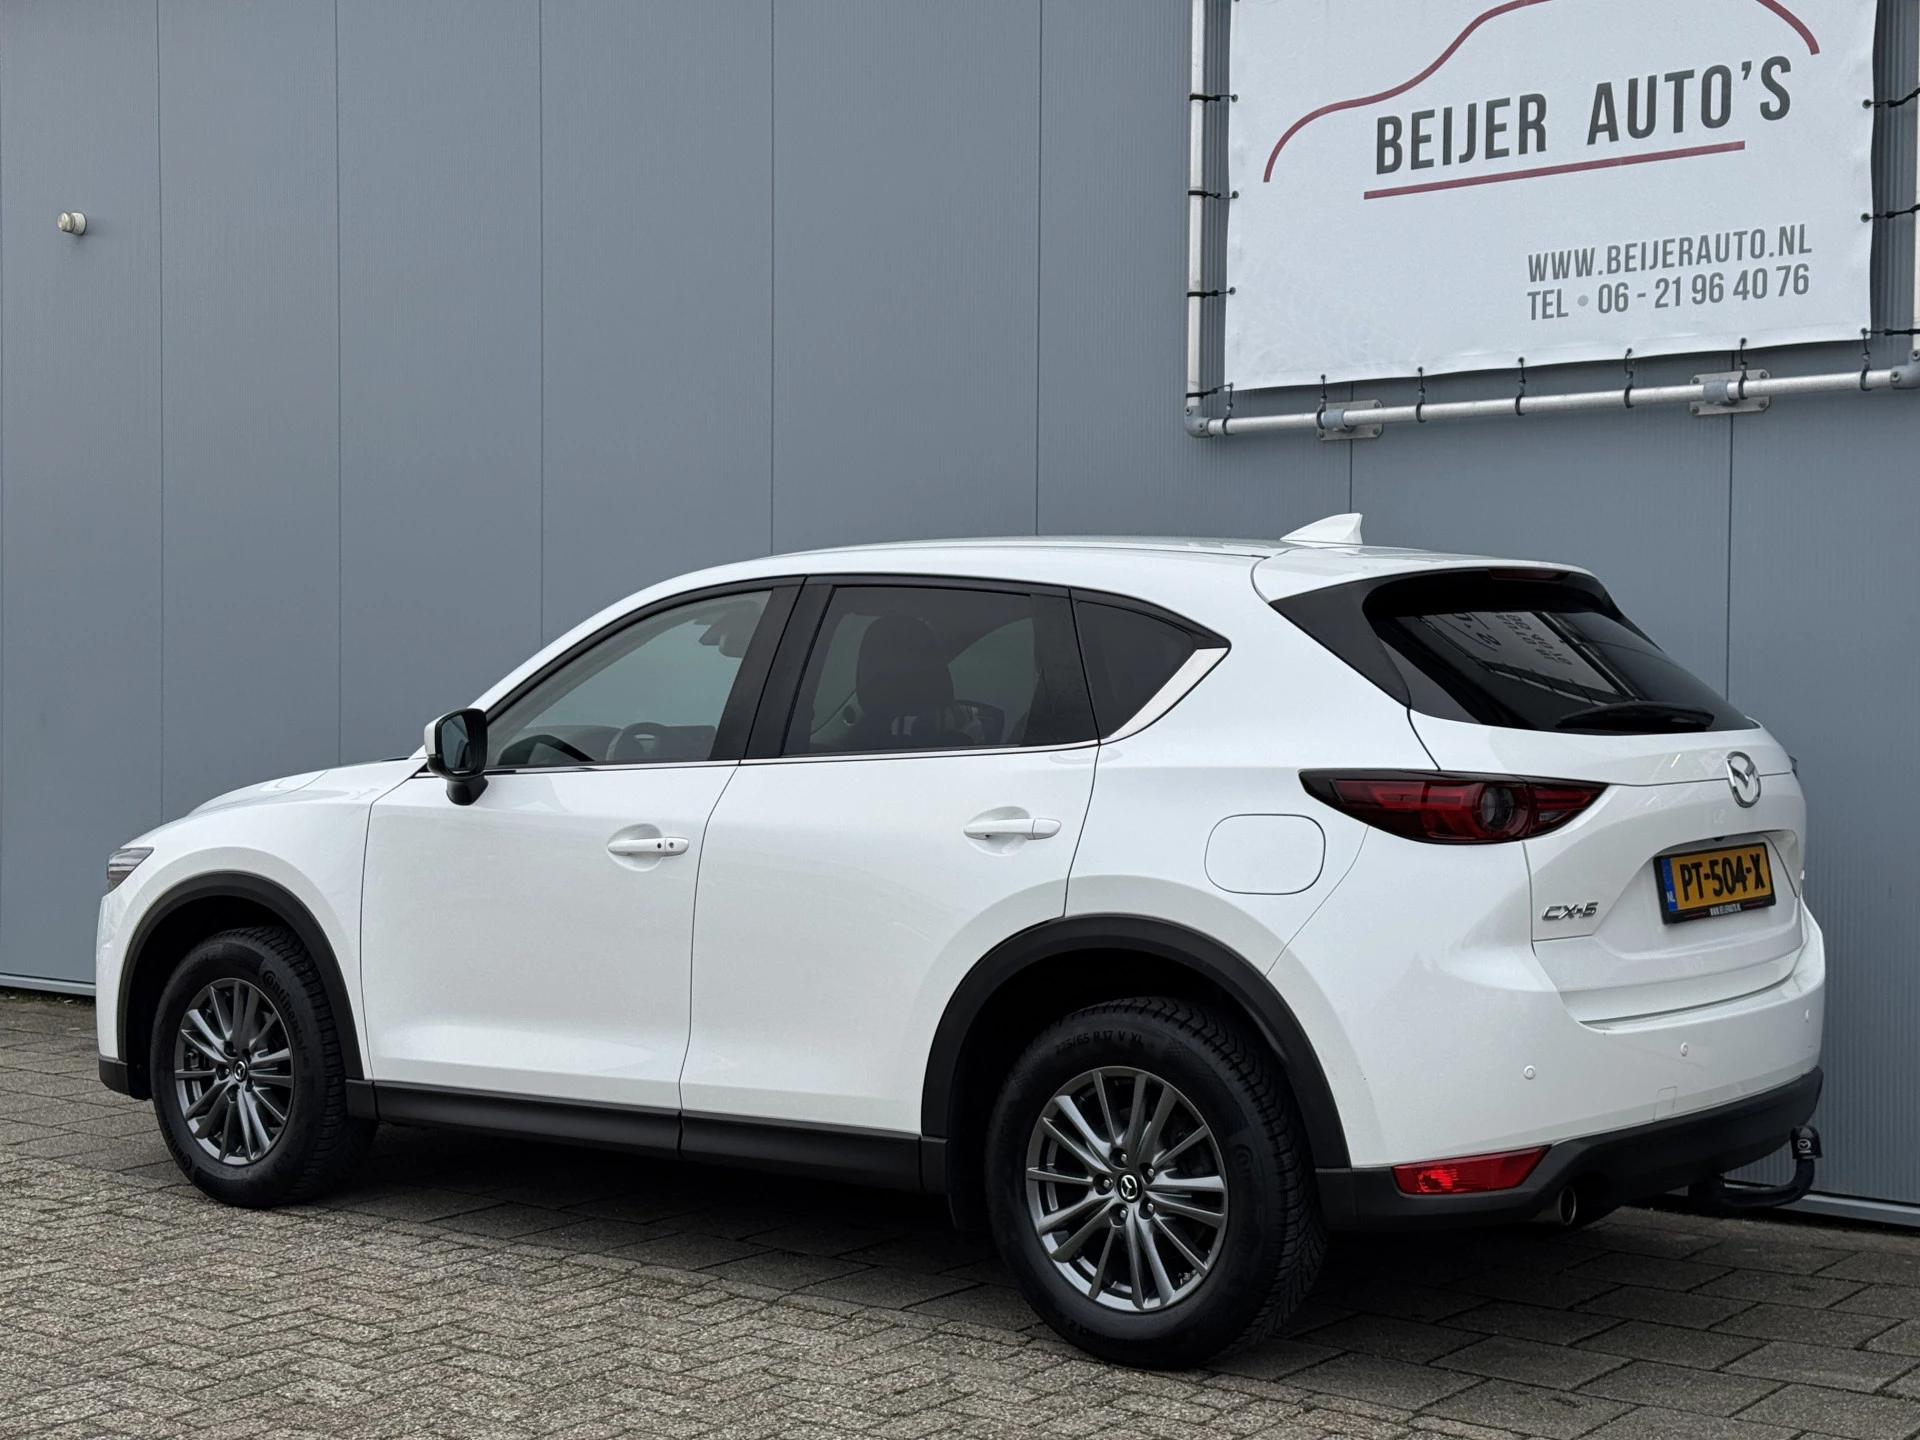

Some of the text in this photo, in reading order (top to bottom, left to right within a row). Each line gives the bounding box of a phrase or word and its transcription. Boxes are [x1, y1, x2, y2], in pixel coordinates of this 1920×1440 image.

[1376, 55, 1791, 175] BEIJER AUTO'S
[1527, 223, 1813, 283] WWW.BEIJERAUTO.NL
[1526, 289, 1569, 321] TEL
[1597, 281, 1629, 314] 06
[1654, 276, 1681, 309] 21
[1691, 272, 1725, 305] 96
[1732, 267, 1768, 301] 40
[1775, 263, 1810, 297] 76
[1666, 890, 1676, 903] NL
[1679, 853, 1766, 902] PT-504-X
[1541, 900, 1599, 921] CX-5
